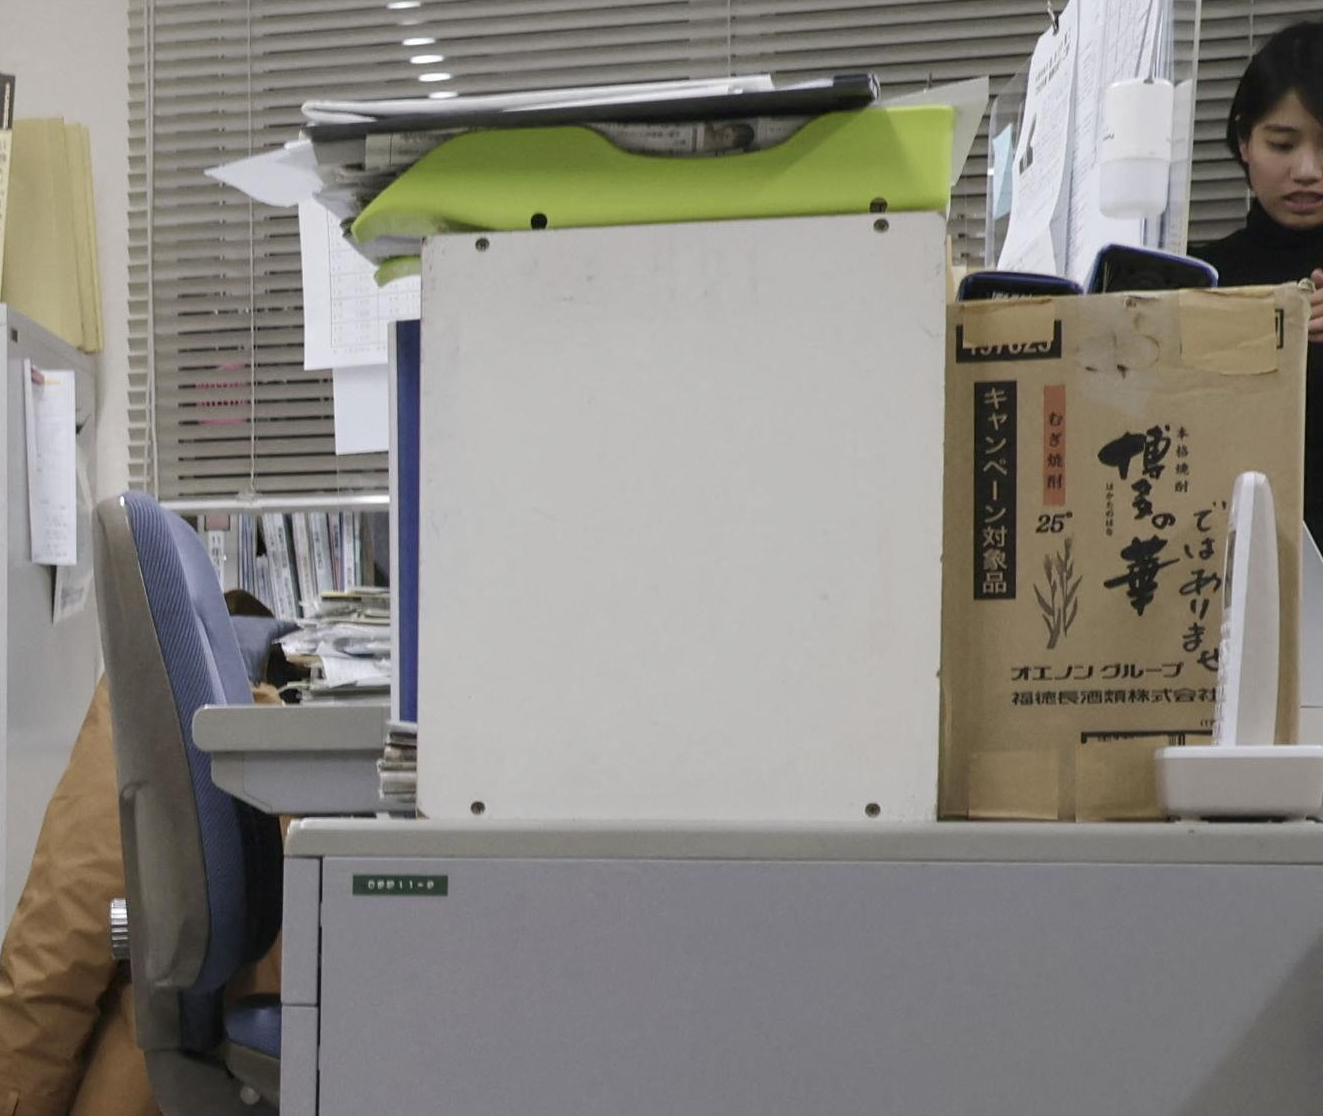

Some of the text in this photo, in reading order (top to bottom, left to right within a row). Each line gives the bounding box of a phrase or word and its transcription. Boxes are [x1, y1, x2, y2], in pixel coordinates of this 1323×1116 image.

[1045, 411, 1064, 491] むぎ焼酎
[1174, 427, 1190, 494] 本格焼酎
[982, 386, 1009, 595] キャンペーン対象品
[1097, 425, 1181, 617] 博多の華
[1011, 661, 1185, 681] オエノン グループ
[1011, 686, 1216, 706] 福徳長酒類株式会社
